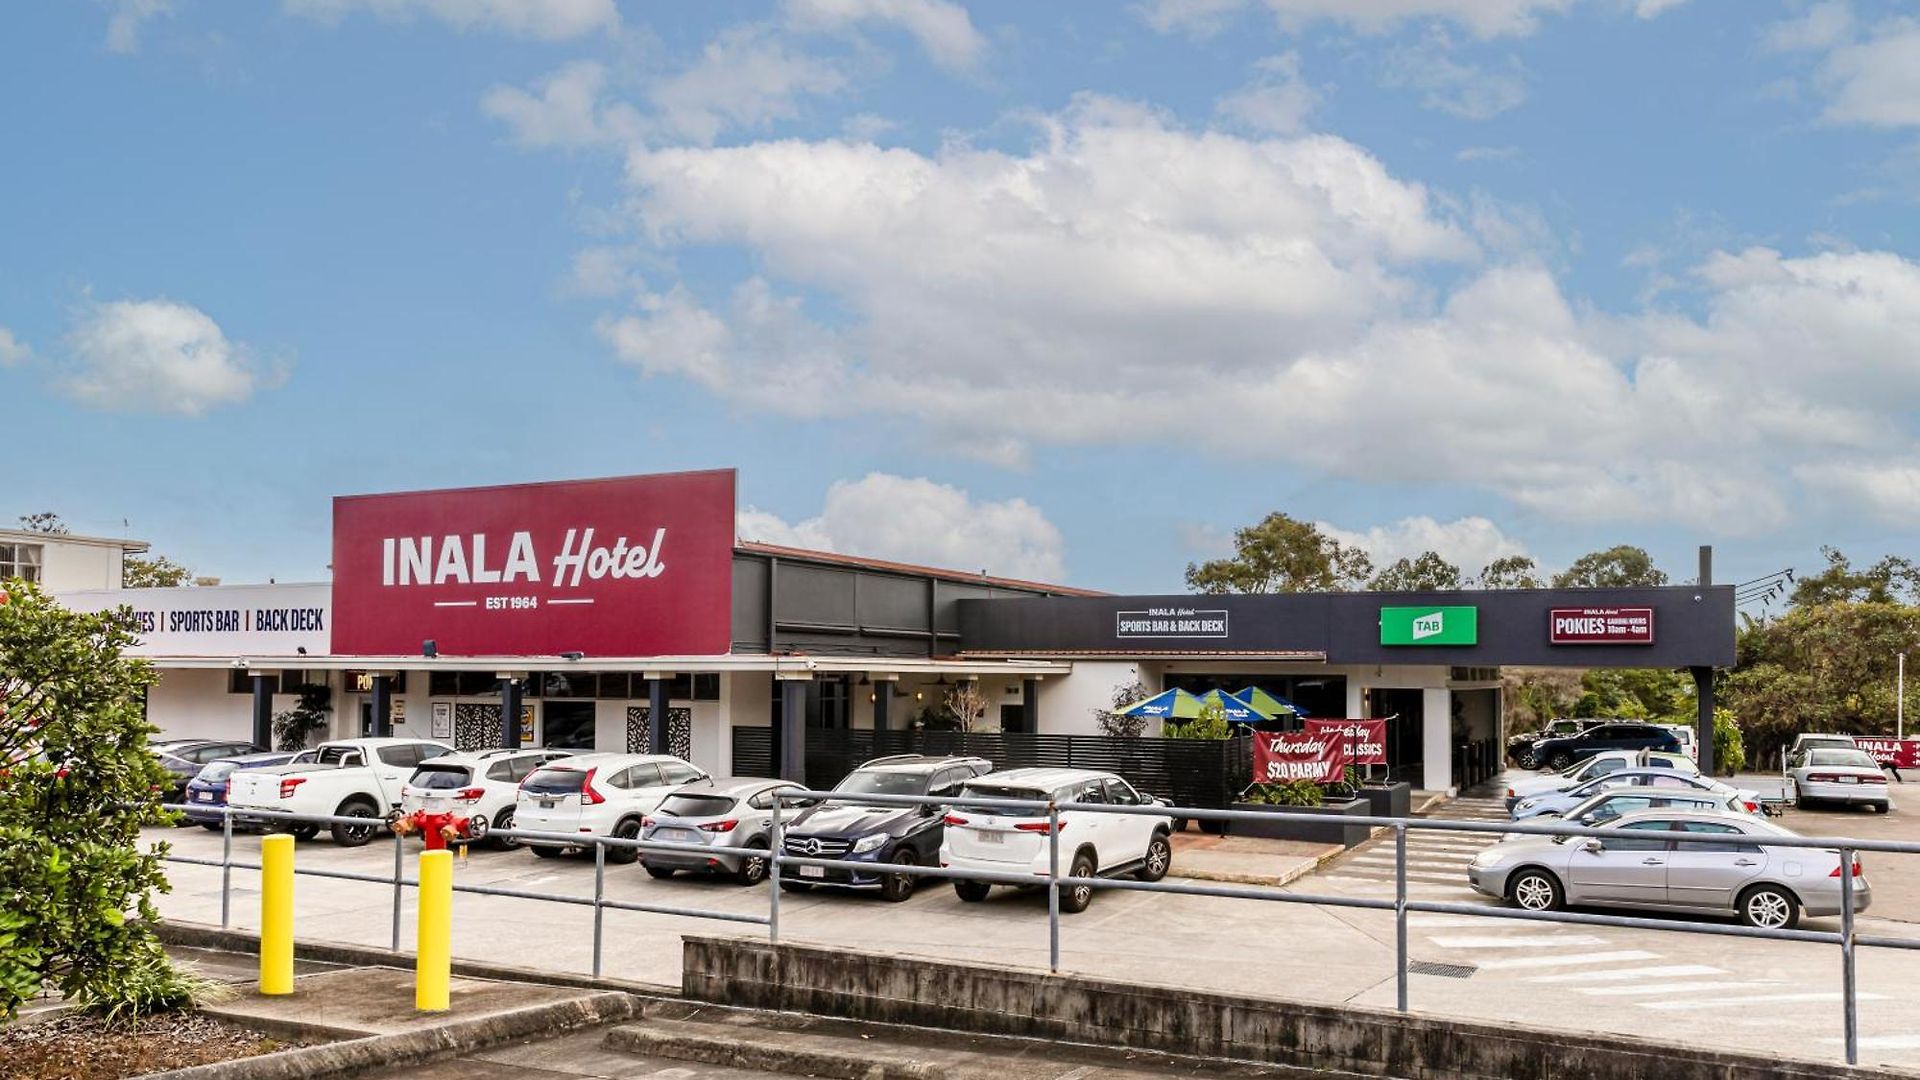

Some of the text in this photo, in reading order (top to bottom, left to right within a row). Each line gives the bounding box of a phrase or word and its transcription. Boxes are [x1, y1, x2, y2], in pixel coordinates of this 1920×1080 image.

[383, 528, 666, 587] INALA Hotel
[485, 597, 538, 609] EST 1964
[1148, 608, 1176, 616] INALA
[170, 610, 213, 632] SPORTS
[216, 610, 239, 632] BAR
[256, 609, 288, 631] BACK
[291, 609, 323, 631] DECK
[1120, 620, 1224, 632] SPORTS BAR & BACK DECK
[1416, 621, 1440, 631] TAB
[1556, 617, 1606, 634] POKIES
[1269, 735, 1327, 760] Thursday
[1858, 741, 1902, 752] INALA
[1266, 760, 1331, 779] $20 PARMY
